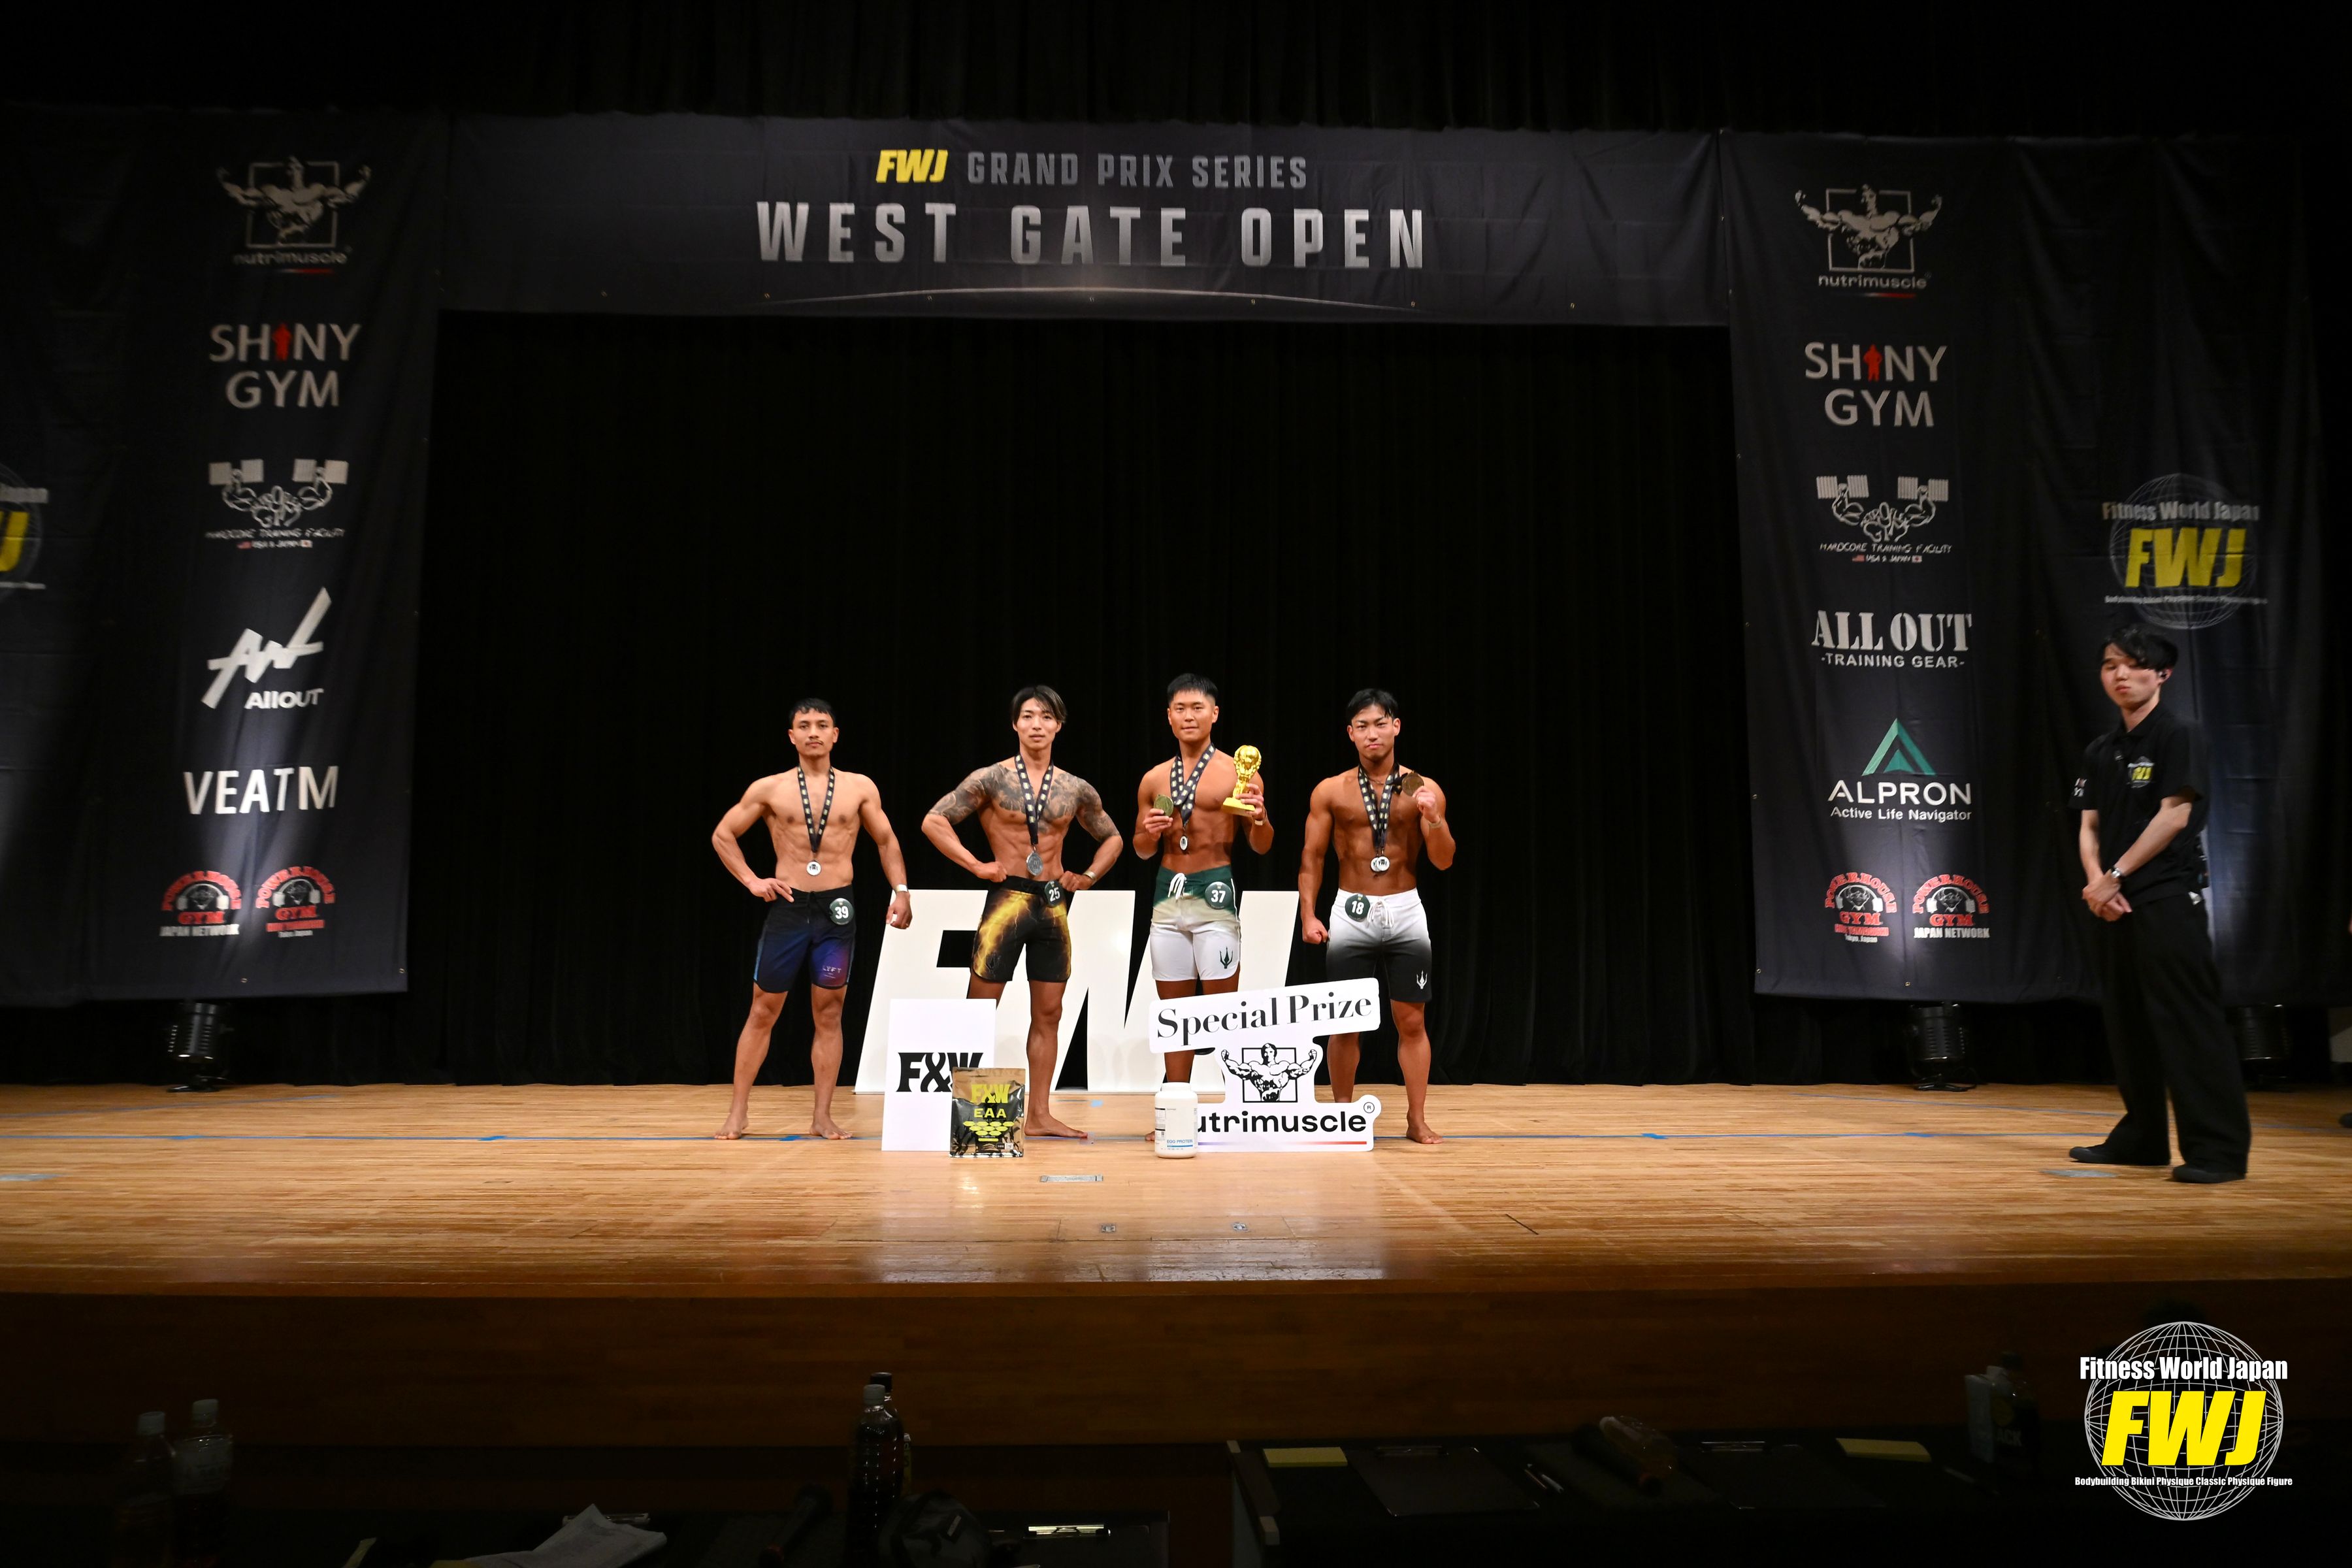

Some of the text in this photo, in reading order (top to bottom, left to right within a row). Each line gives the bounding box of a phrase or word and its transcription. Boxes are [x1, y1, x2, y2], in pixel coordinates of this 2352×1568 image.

[875, 149, 1307, 189] FWJ GRAND PRIX SERIES
[757, 201, 1422, 269] WEST GATE OPEN
[1818, 274, 1927, 289] nutrimuscle
[226, 370, 339, 409] GYM
[1825, 388, 1934, 427] GYM
[2102, 501, 2155, 521] Fitness
[2160, 501, 2210, 520] World
[1820, 542, 1867, 553] HARDCORE
[1871, 543, 1912, 553] TRAINING
[2125, 527, 2246, 587] FWJ
[1811, 610, 1972, 652] ALL OUT
[183, 766, 338, 815] VEATM
[1828, 779, 1972, 806] ALPRON
[1831, 806, 1972, 823] Active Life Navigator
[1049, 887, 1060, 902] 25
[1211, 890, 1226, 903] 37
[1825, 872, 1897, 913] POWERHOUSE
[1912, 874, 1990, 914] POWERHOUSE
[835, 906, 849, 919] 39
[1352, 900, 1364, 915] 18
[1840, 911, 1883, 925] GYM
[1929, 913, 1975, 926] GYM
[1914, 927, 1990, 938] JAPAN NETWORK
[1158, 991, 1371, 1046] Special Prize
[972, 1084, 1011, 1103] F&W
[974, 1108, 1007, 1118] EAA
